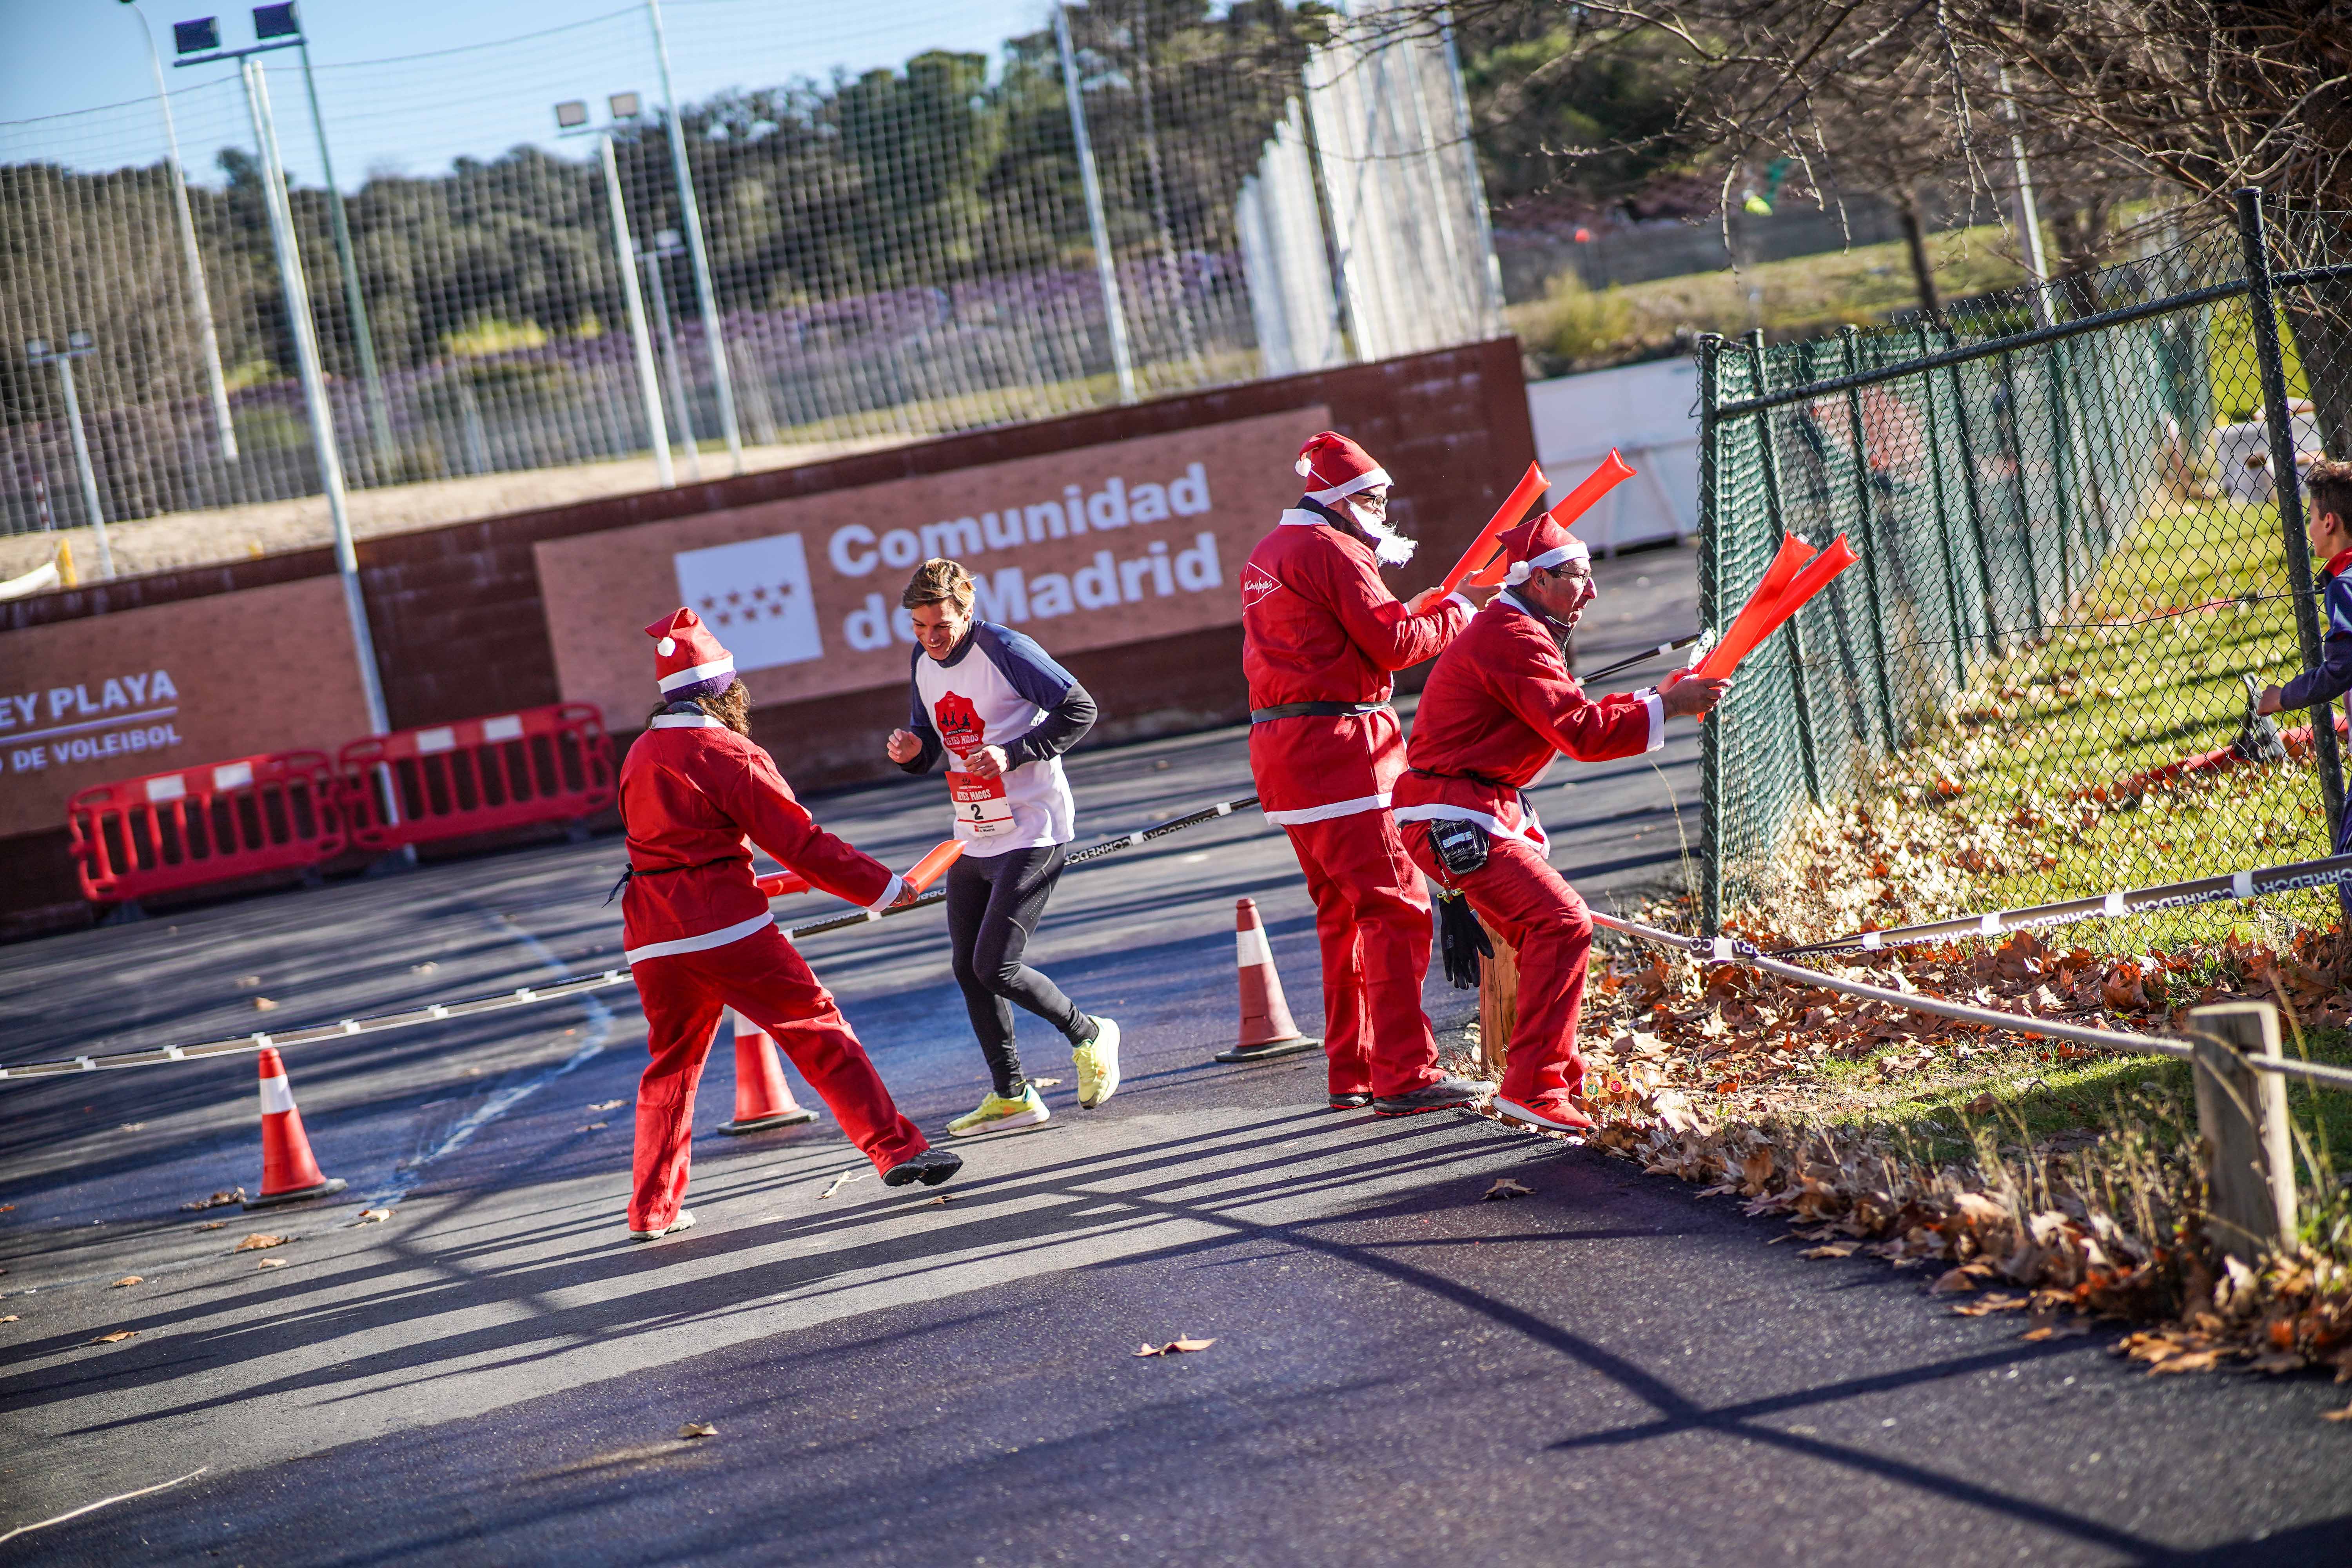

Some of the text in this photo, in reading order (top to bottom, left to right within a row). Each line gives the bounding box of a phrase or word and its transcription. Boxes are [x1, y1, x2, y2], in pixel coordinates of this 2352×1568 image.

[828, 462, 1212, 577] Comunidad
[975, 532, 1223, 624] Madrid
[48, 669, 179, 720] PLAYA
[12, 746, 48, 772] DE
[53, 723, 183, 764] VOLEIBOL
[961, 734, 979, 744] MAGOS
[969, 789, 991, 800] MAGOS
[971, 804, 984, 820] 2
